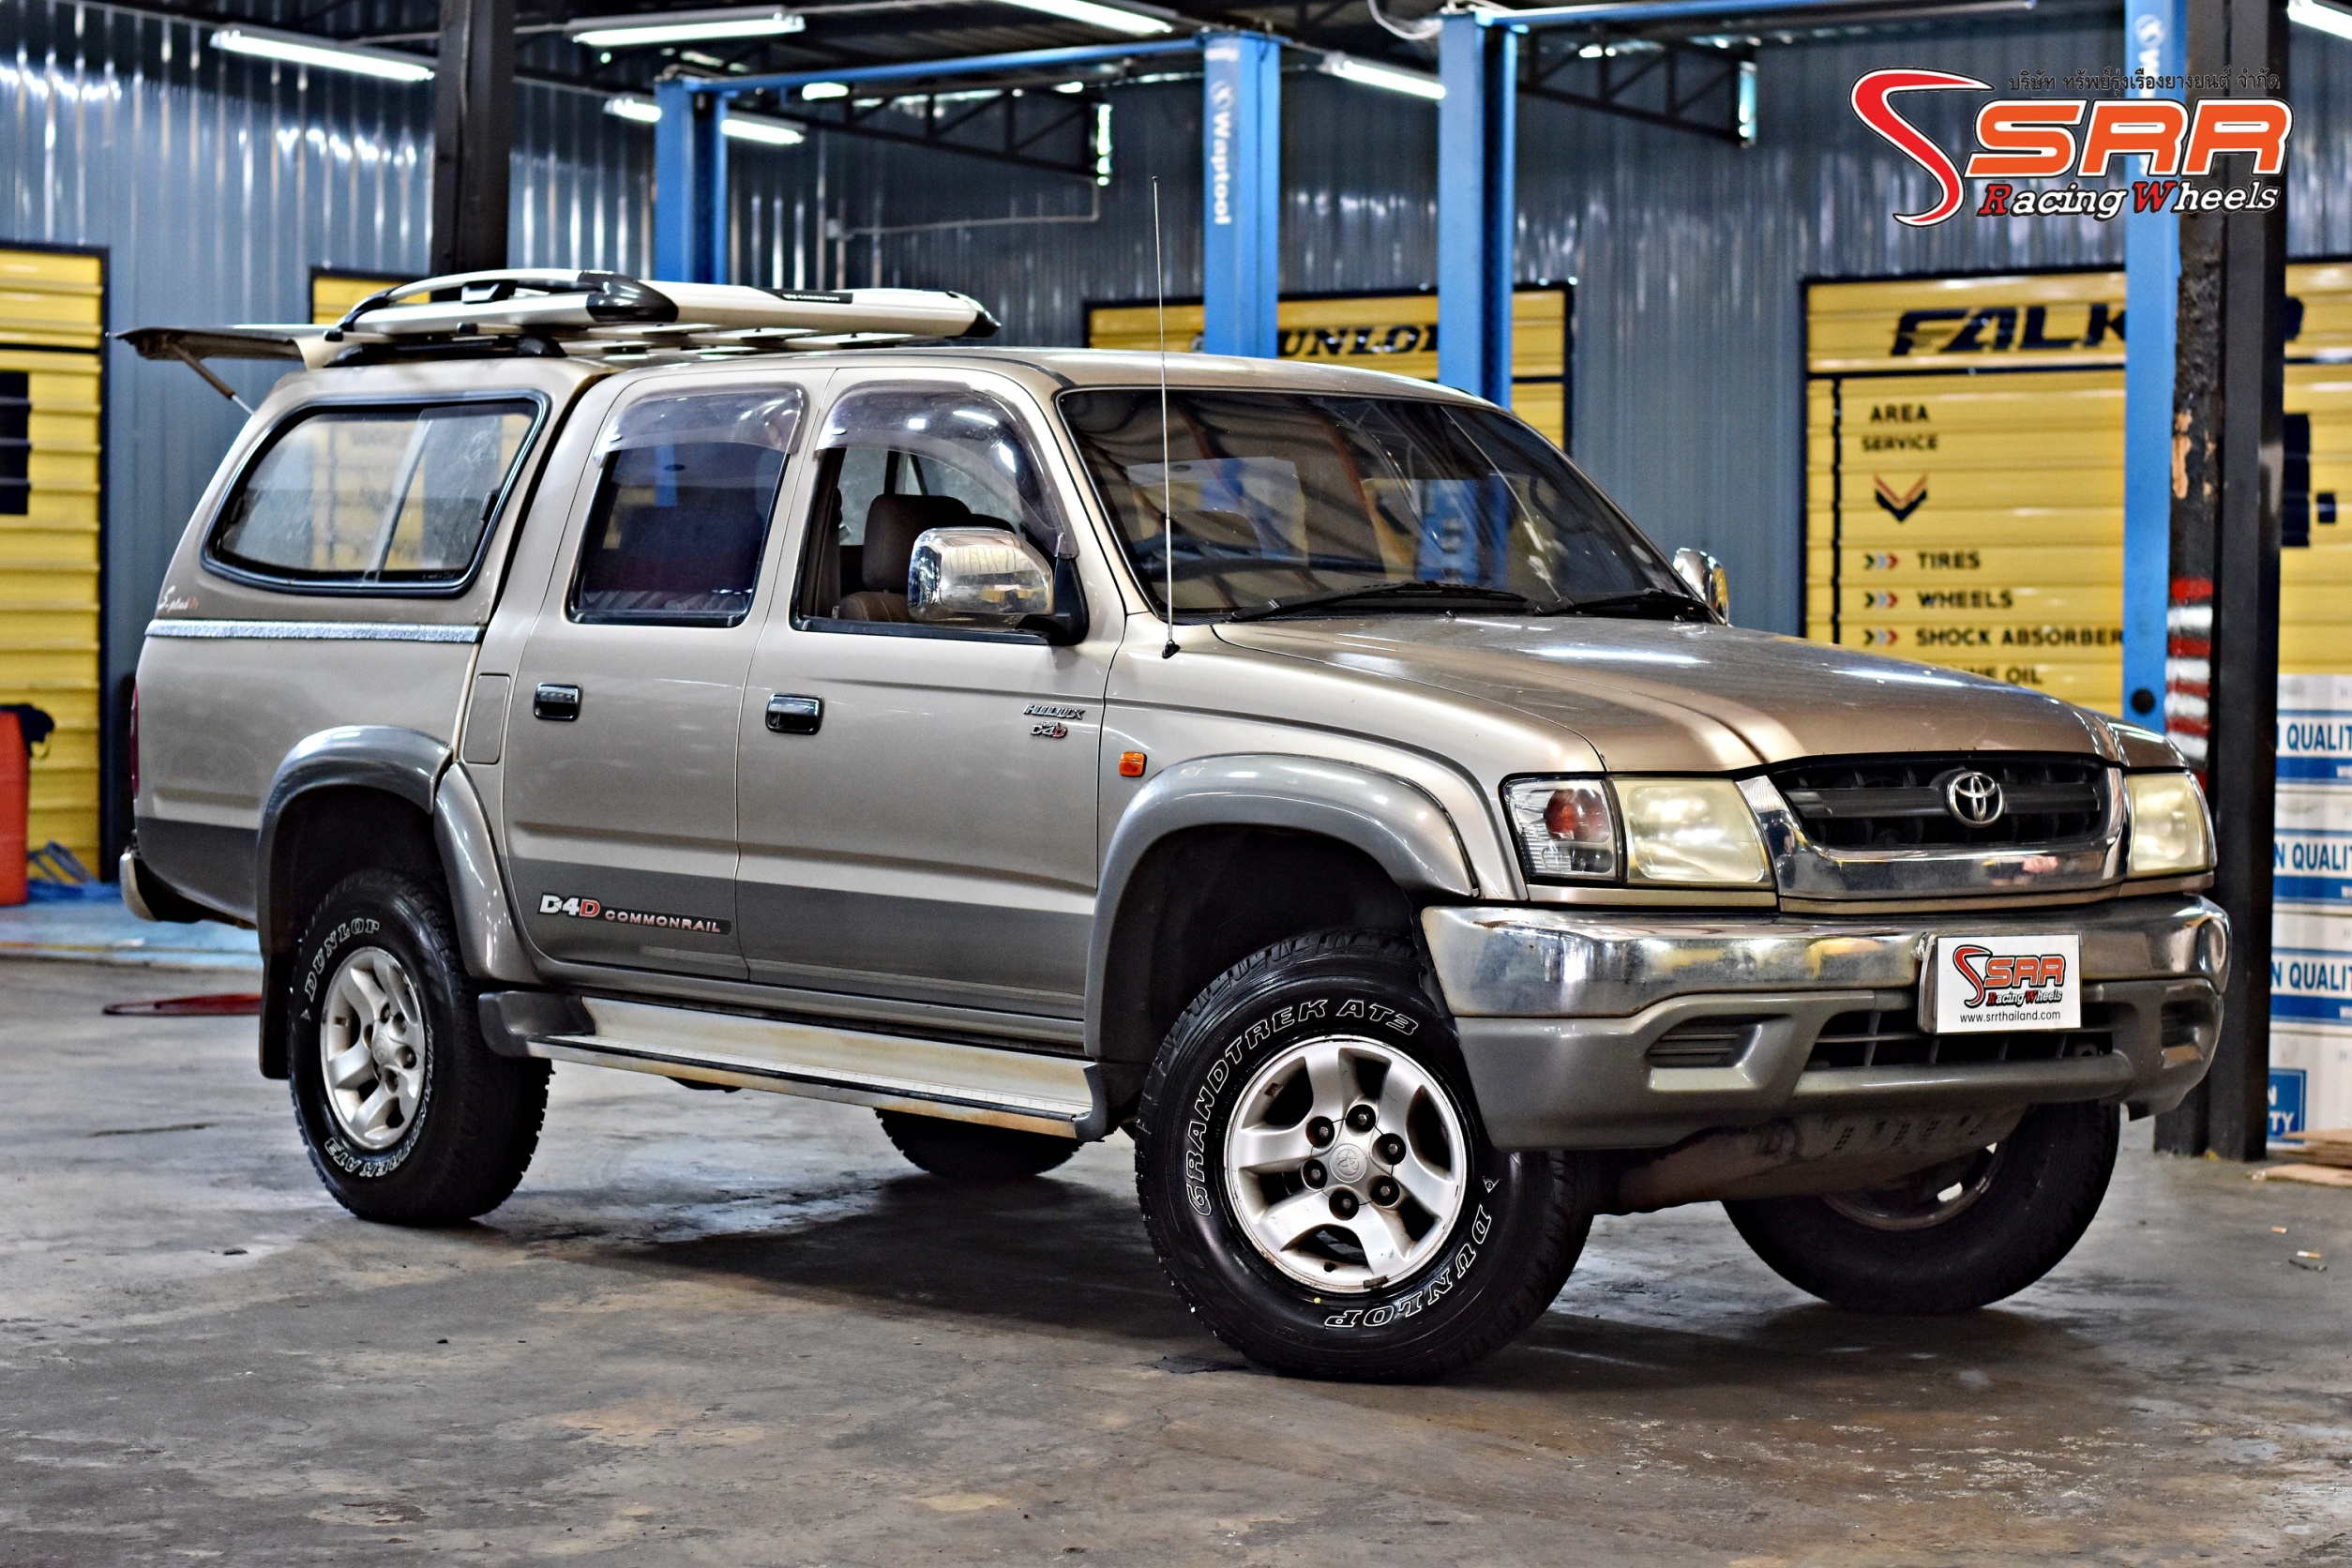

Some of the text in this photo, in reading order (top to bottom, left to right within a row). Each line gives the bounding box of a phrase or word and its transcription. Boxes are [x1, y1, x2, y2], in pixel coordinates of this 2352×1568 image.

[1891, 302, 2127, 356] FALK
[1277, 324, 1439, 357] UNLO
[1869, 404, 1930, 423] AREA
[1862, 434, 1938, 452] SERVICE
[1918, 551, 1981, 569] TIRES
[1918, 590, 2013, 609] WHEELS
[1916, 627, 1992, 646] SHOCK
[2006, 667, 2043, 685] OIL
[1023, 704, 1085, 719] HILUX
[538, 893, 721, 934] D4D COMMONRAIL
[304, 917, 381, 1003] DUNLOP
[1986, 988, 2063, 1008] Racing Wheels
[1959, 1010, 2061, 1023] www.srrthailand.com
[1185, 999, 1421, 1217] GRANDTREK AT3
[1323, 1204, 1493, 1329] DUNLOP
